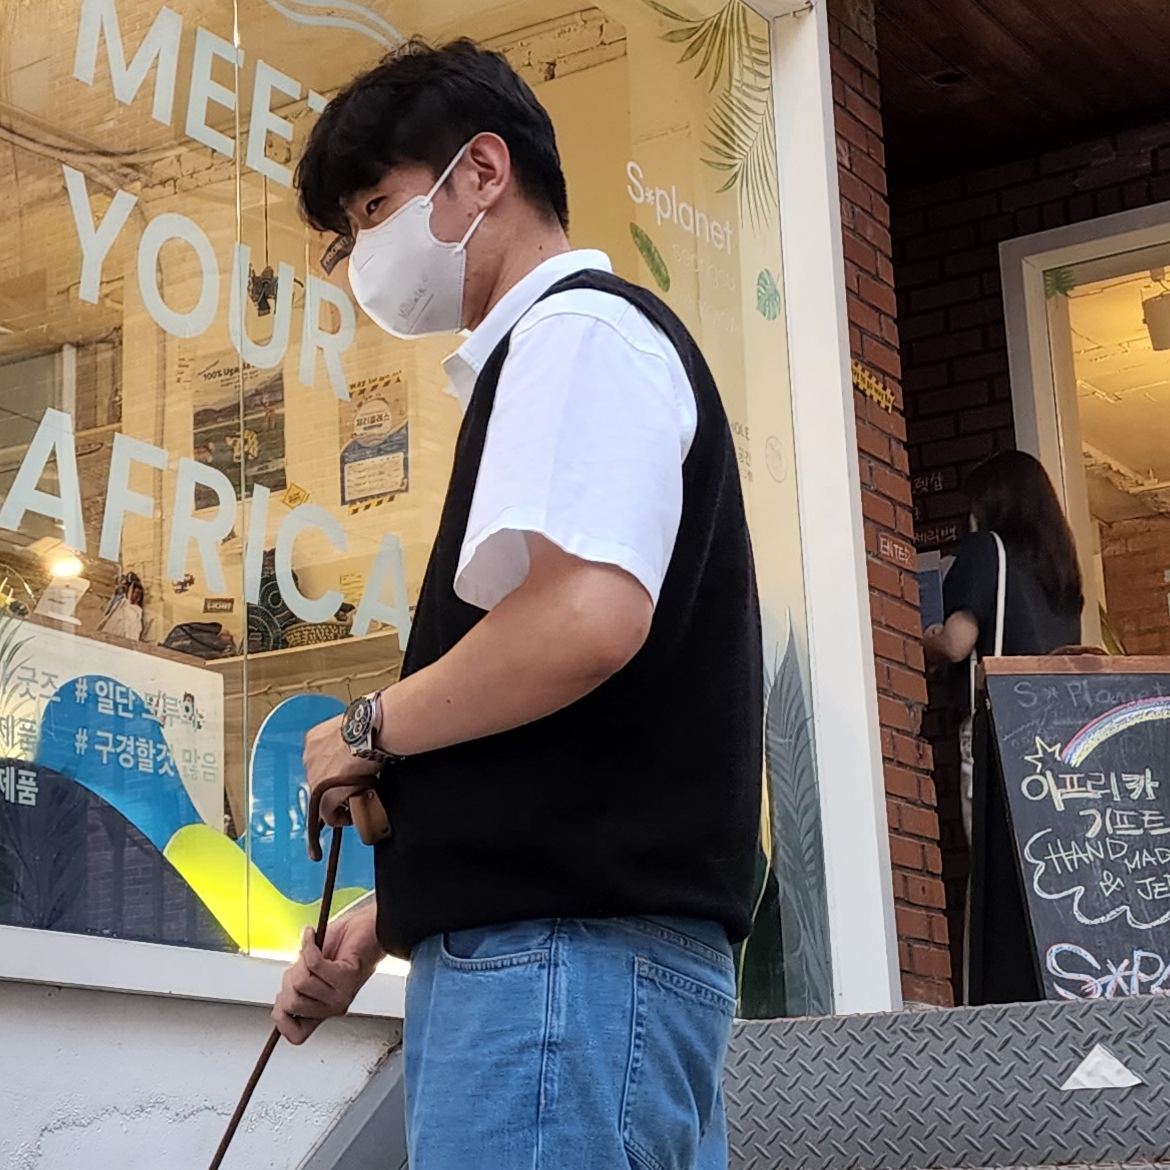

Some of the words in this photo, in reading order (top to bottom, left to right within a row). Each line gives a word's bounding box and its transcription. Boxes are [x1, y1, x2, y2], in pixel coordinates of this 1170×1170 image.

[63, 165, 356, 402] YOUR
[879, 537, 911, 565] ENTER
[95, 680, 137, 720] 일단
[1020, 767, 1160, 812] 아프리카
[1079, 807, 1170, 838] 기프트
